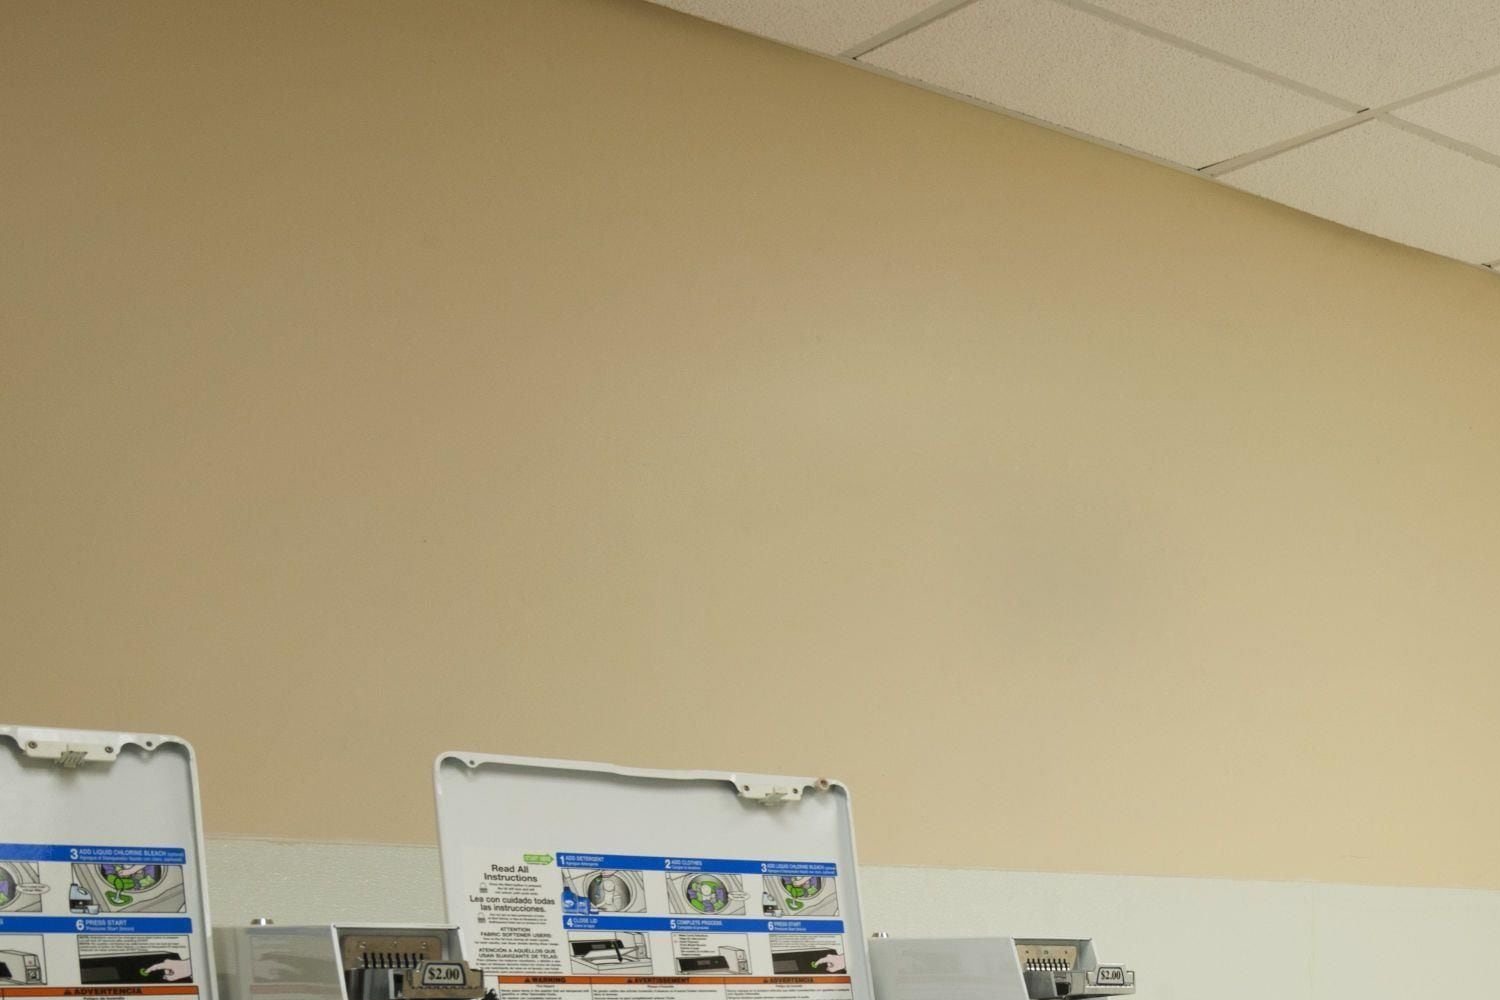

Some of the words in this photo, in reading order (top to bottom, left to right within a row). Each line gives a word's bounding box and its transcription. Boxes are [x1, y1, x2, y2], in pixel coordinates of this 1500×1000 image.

[70, 848, 79, 860] 3
[560, 855, 565, 865] 1
[664, 859, 671, 869] 2
[491, 864, 515, 873] Read
[518, 865, 529, 873] All
[761, 863, 767, 873] 3
[484, 873, 538, 882] Instructions
[469, 895, 484, 903] Lea
[502, 896, 532, 904] cuidado
[534, 897, 555, 905] todas
[76, 919, 84, 931] 6
[566, 918, 574, 928] 4
[670, 919, 676, 929] 5
[768, 921, 774, 931] 6
[428, 967, 460, 980] $2.00
[1100, 970, 1121, 980] $2.00
[531, 976, 566, 984] WARNING
[74, 987, 143, 996] ADVERTENCIA
